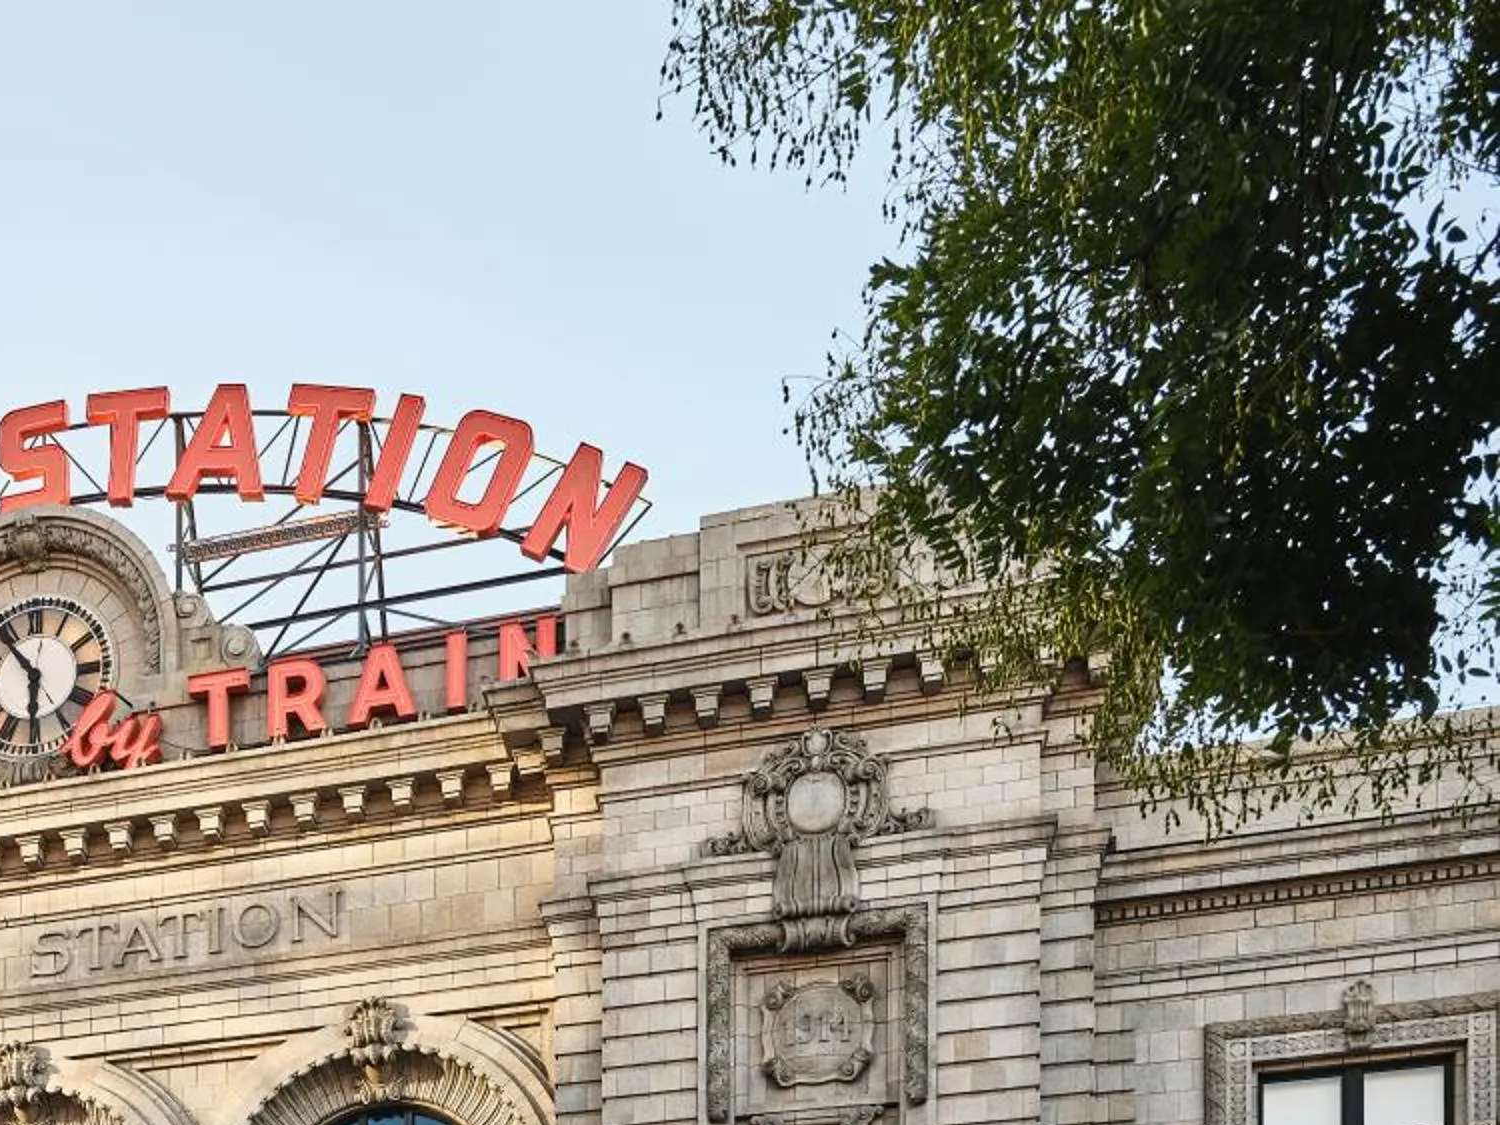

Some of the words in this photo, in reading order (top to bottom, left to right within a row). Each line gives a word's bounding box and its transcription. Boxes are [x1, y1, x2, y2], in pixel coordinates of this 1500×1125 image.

[60, 688, 164, 770] by
[188, 613, 558, 750] TRAIN
[29, 886, 345, 979] STATION
